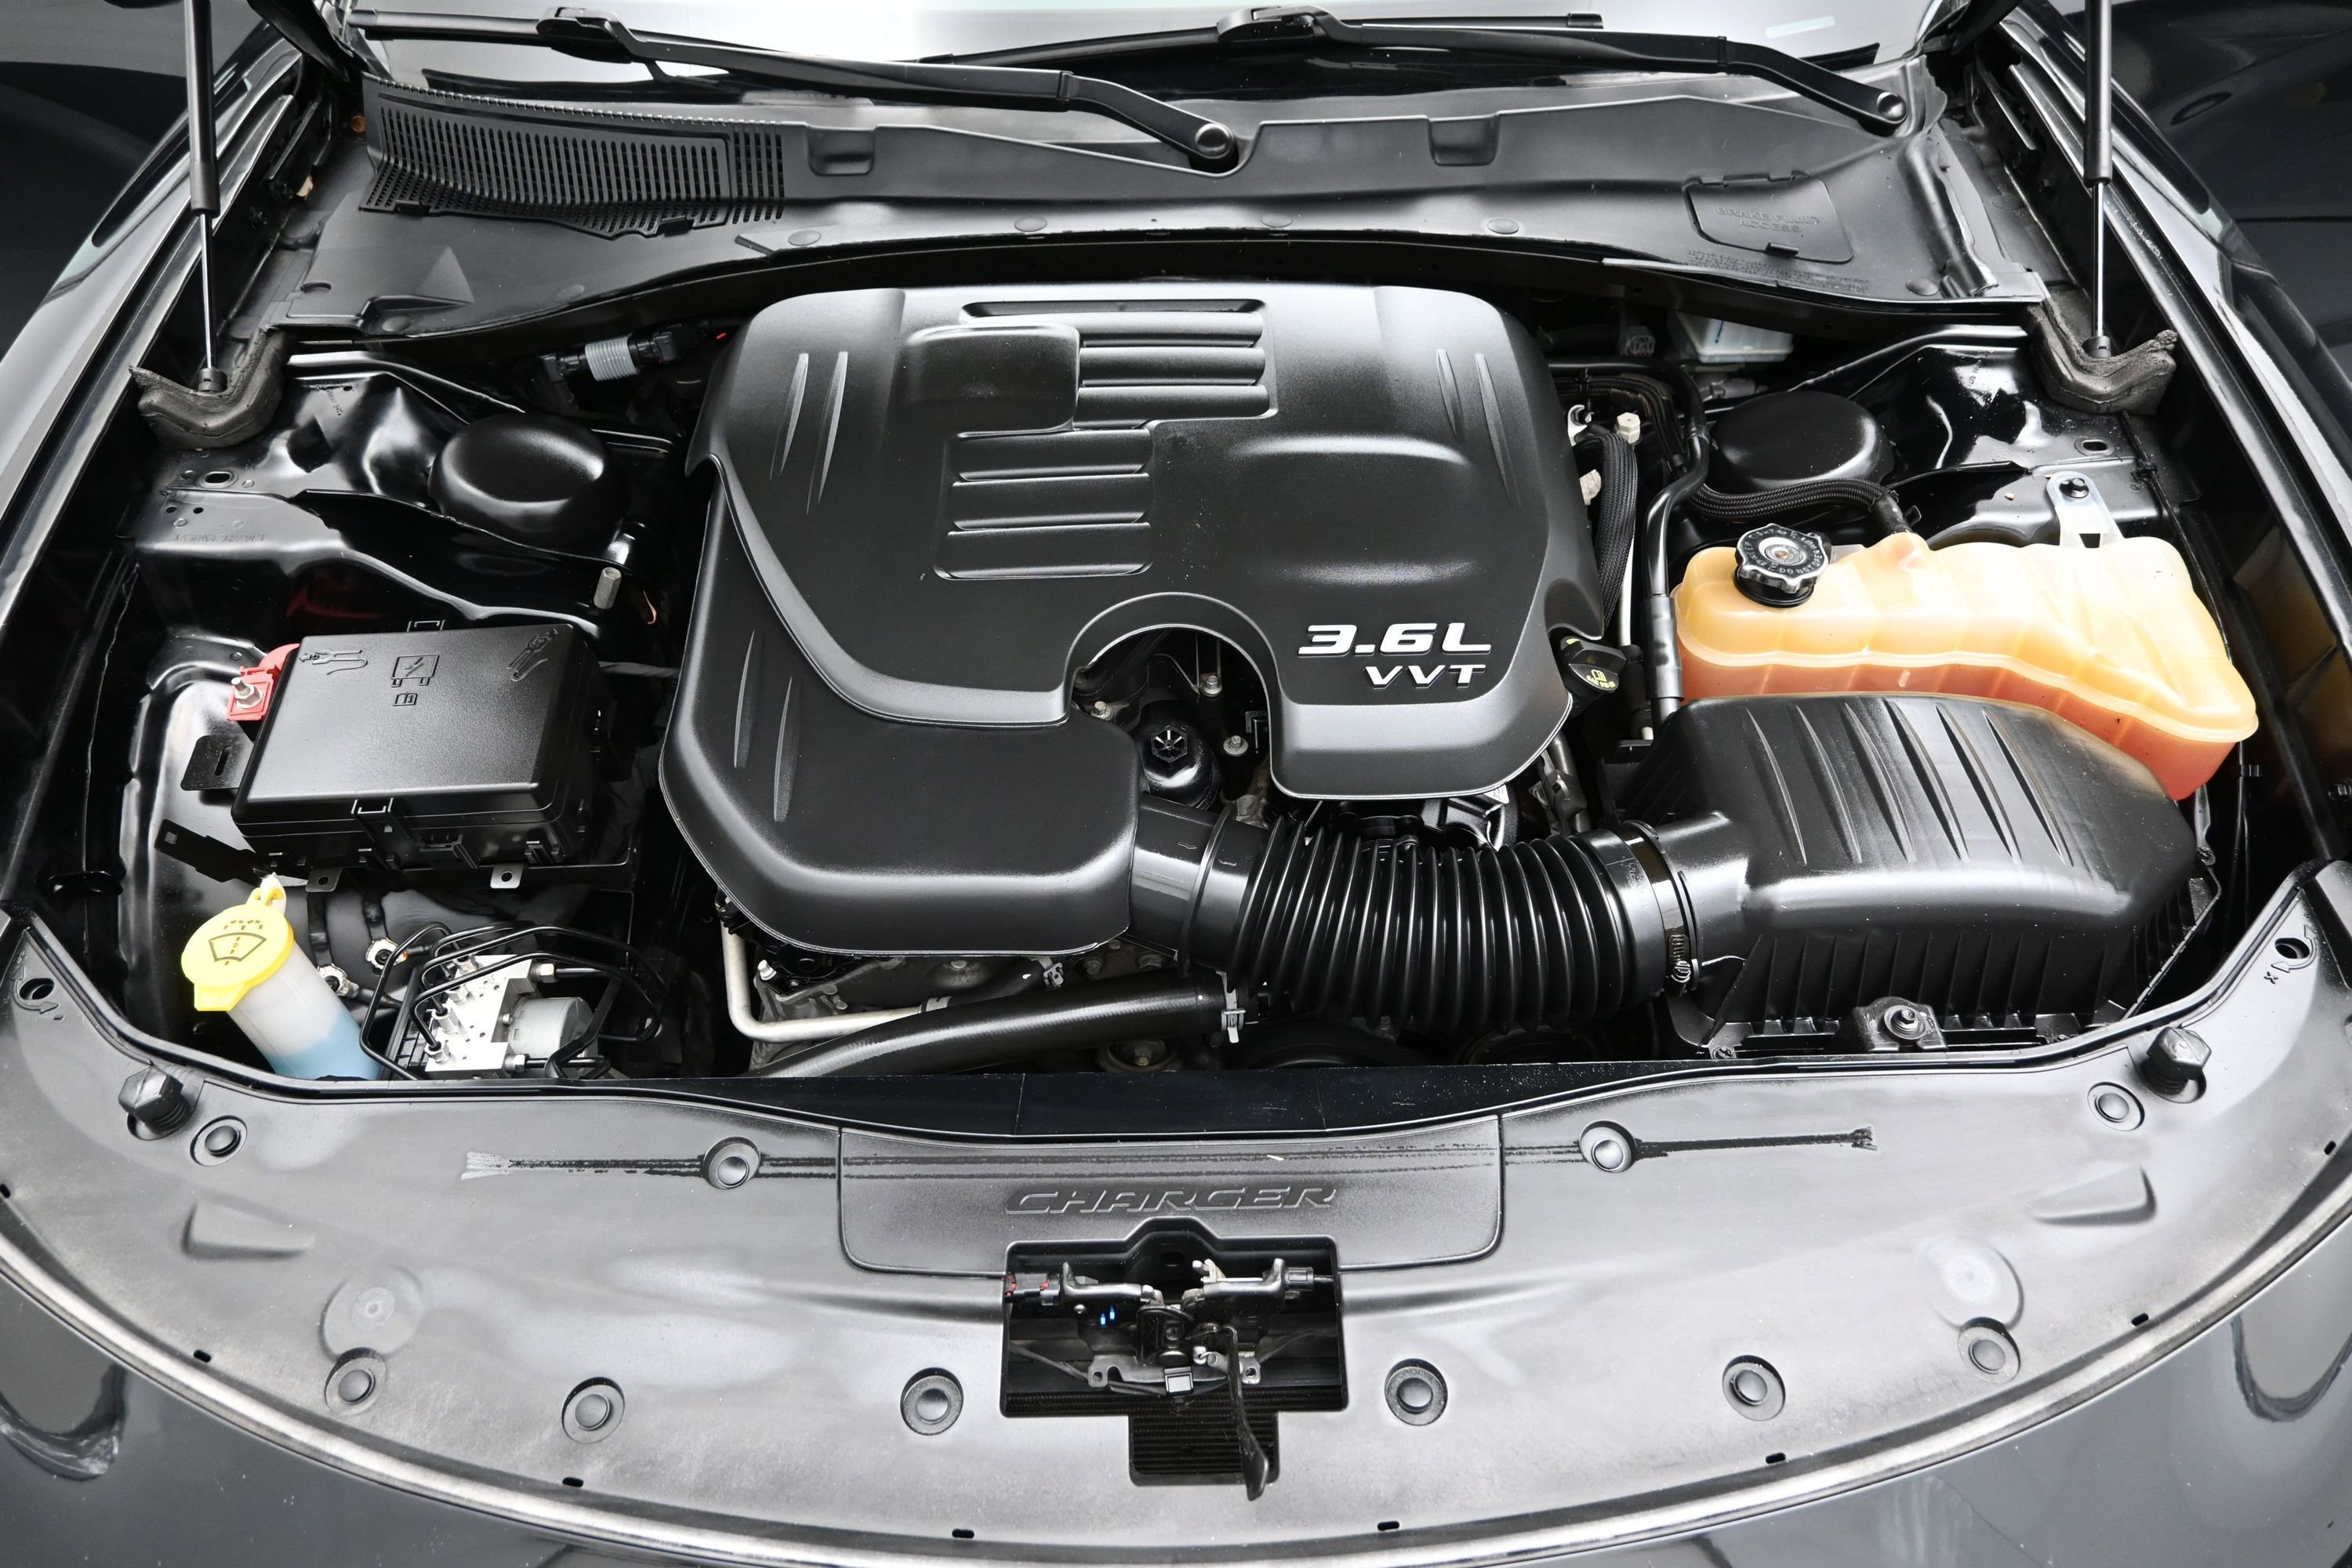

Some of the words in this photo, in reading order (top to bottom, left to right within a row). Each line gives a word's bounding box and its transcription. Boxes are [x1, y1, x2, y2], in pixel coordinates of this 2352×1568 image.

[1716, 206, 1770, 220] BRAKE
[1739, 219, 1802, 232] ACCESS
[1298, 622, 1492, 658] 3.6L
[1364, 664, 1486, 689] VVT
[1006, 1186, 1338, 1215] CHARGER
